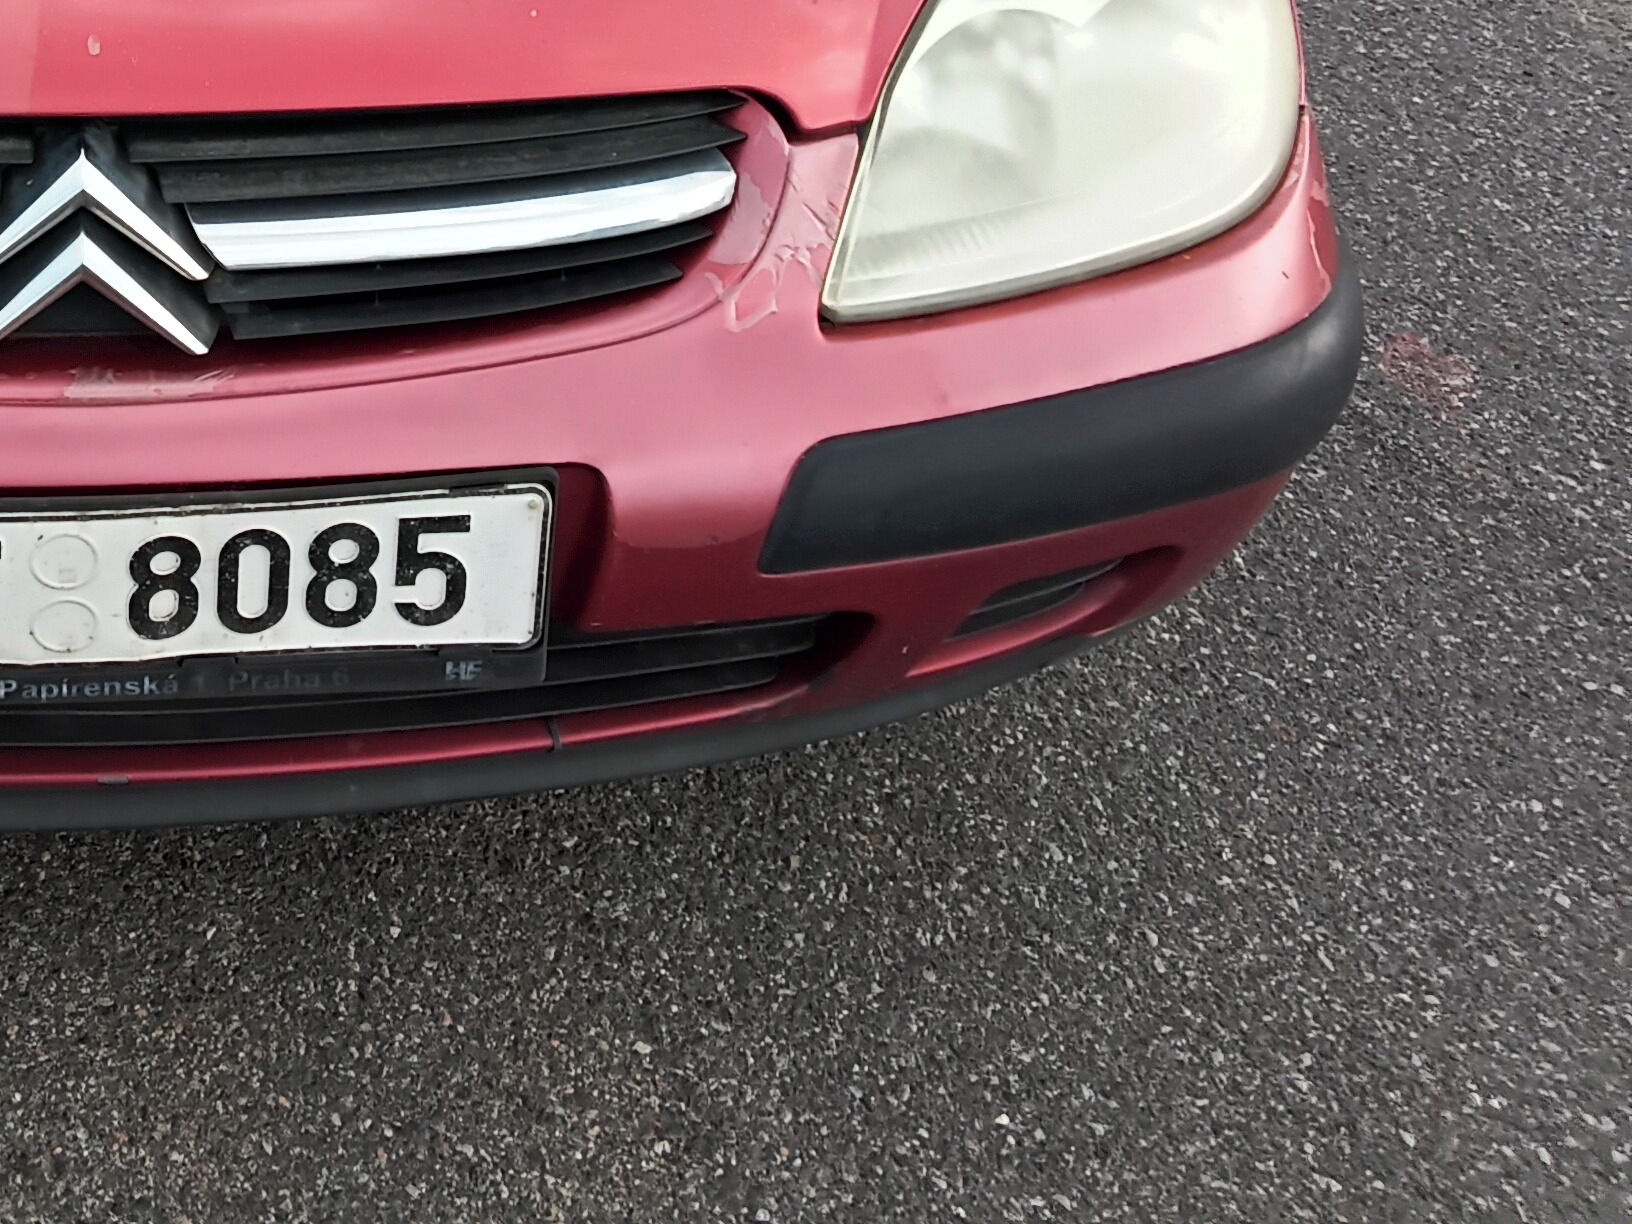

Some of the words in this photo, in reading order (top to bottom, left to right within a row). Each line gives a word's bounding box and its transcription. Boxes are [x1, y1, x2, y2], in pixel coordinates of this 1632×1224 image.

[127, 514, 472, 641] 8085
[229, 667, 320, 693] Praha
[331, 666, 350, 687] 6
